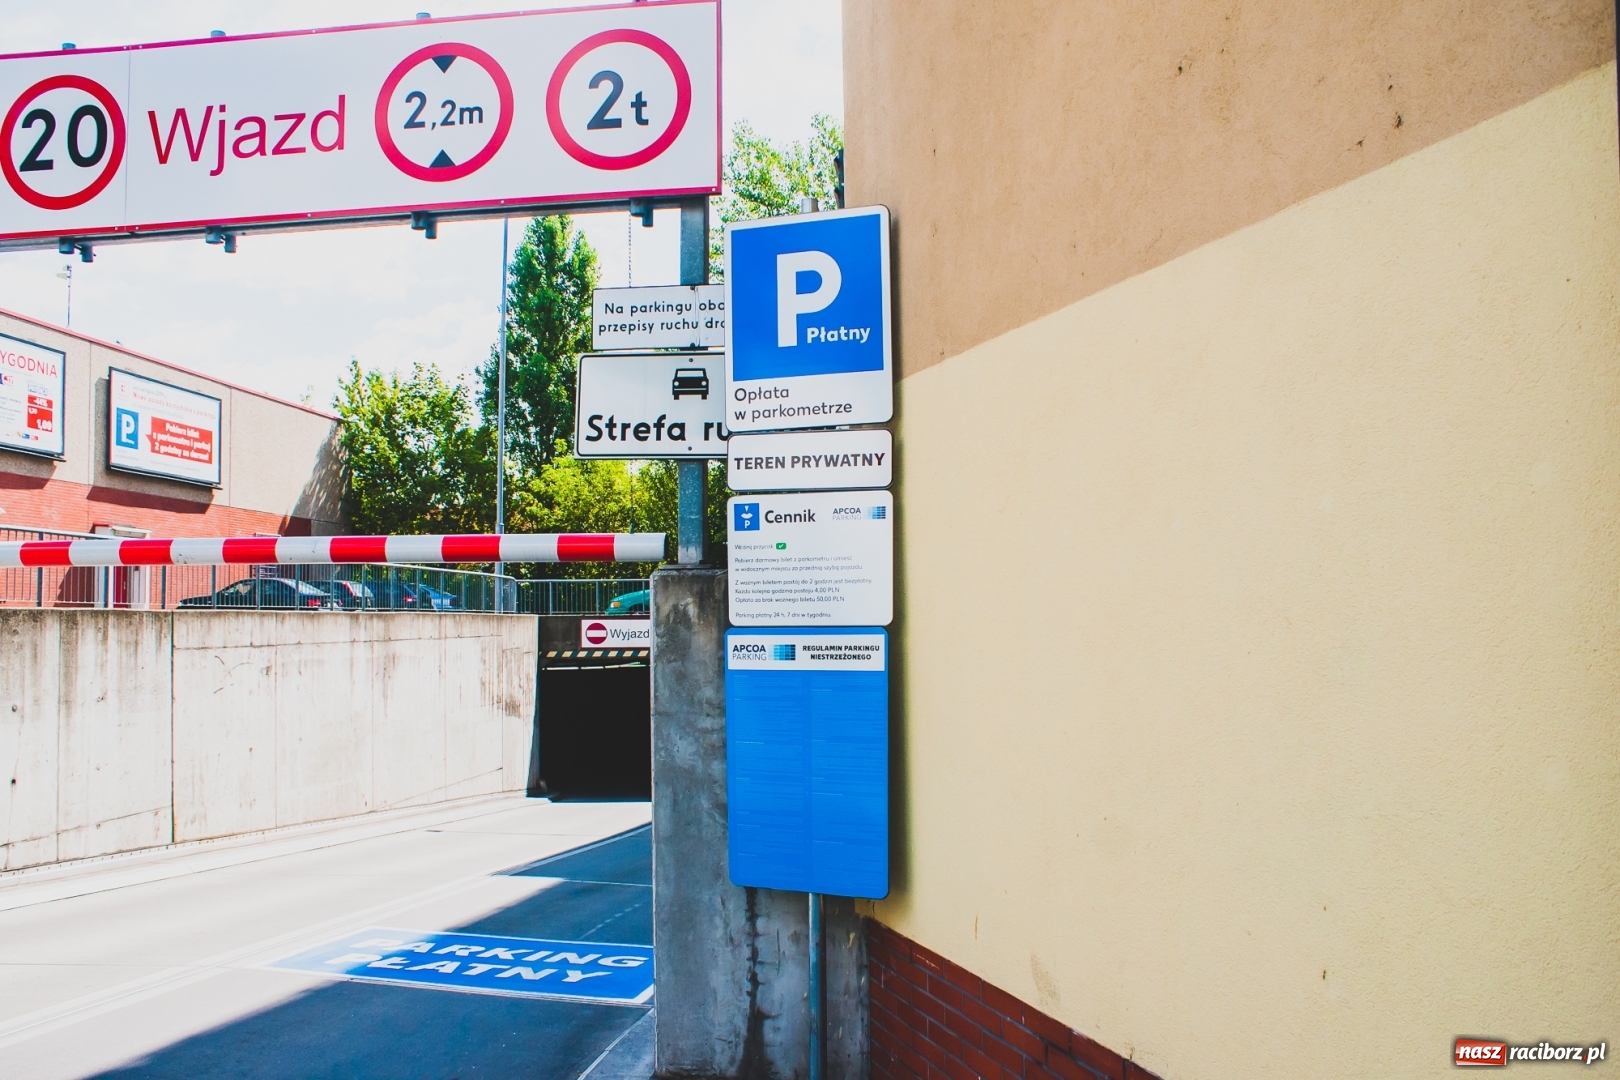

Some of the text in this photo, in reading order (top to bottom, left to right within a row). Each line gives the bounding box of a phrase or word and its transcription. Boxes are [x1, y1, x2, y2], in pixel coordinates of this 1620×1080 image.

[403, 90, 485, 131] 2,2m
[19, 104, 109, 173] 20
[148, 95, 347, 177] Wjazd
[777, 250, 843, 348] P
[604, 303, 624, 314] Na
[630, 301, 692, 317] parkingu
[598, 320, 655, 336] przepisy
[660, 318, 699, 331] ruchu
[806, 325, 871, 345] Płatny
[734, 386, 790, 402] Opłata
[734, 401, 853, 422] w parkometrze
[122, 413, 136, 444] P
[585, 413, 687, 442] Strefa
[734, 452, 886, 470] TEREN PRYWATNY
[764, 509, 816, 524] Cennik
[833, 507, 862, 515] APCOA
[610, 628, 650, 641] Wyjazd
[732, 644, 766, 652] APCOA
[732, 653, 767, 661] PARKING
[810, 652, 872, 661] NIESTRZEŻONEGO
[350, 937, 650, 968] PARKING
[324, 952, 613, 983] PŁATNY
